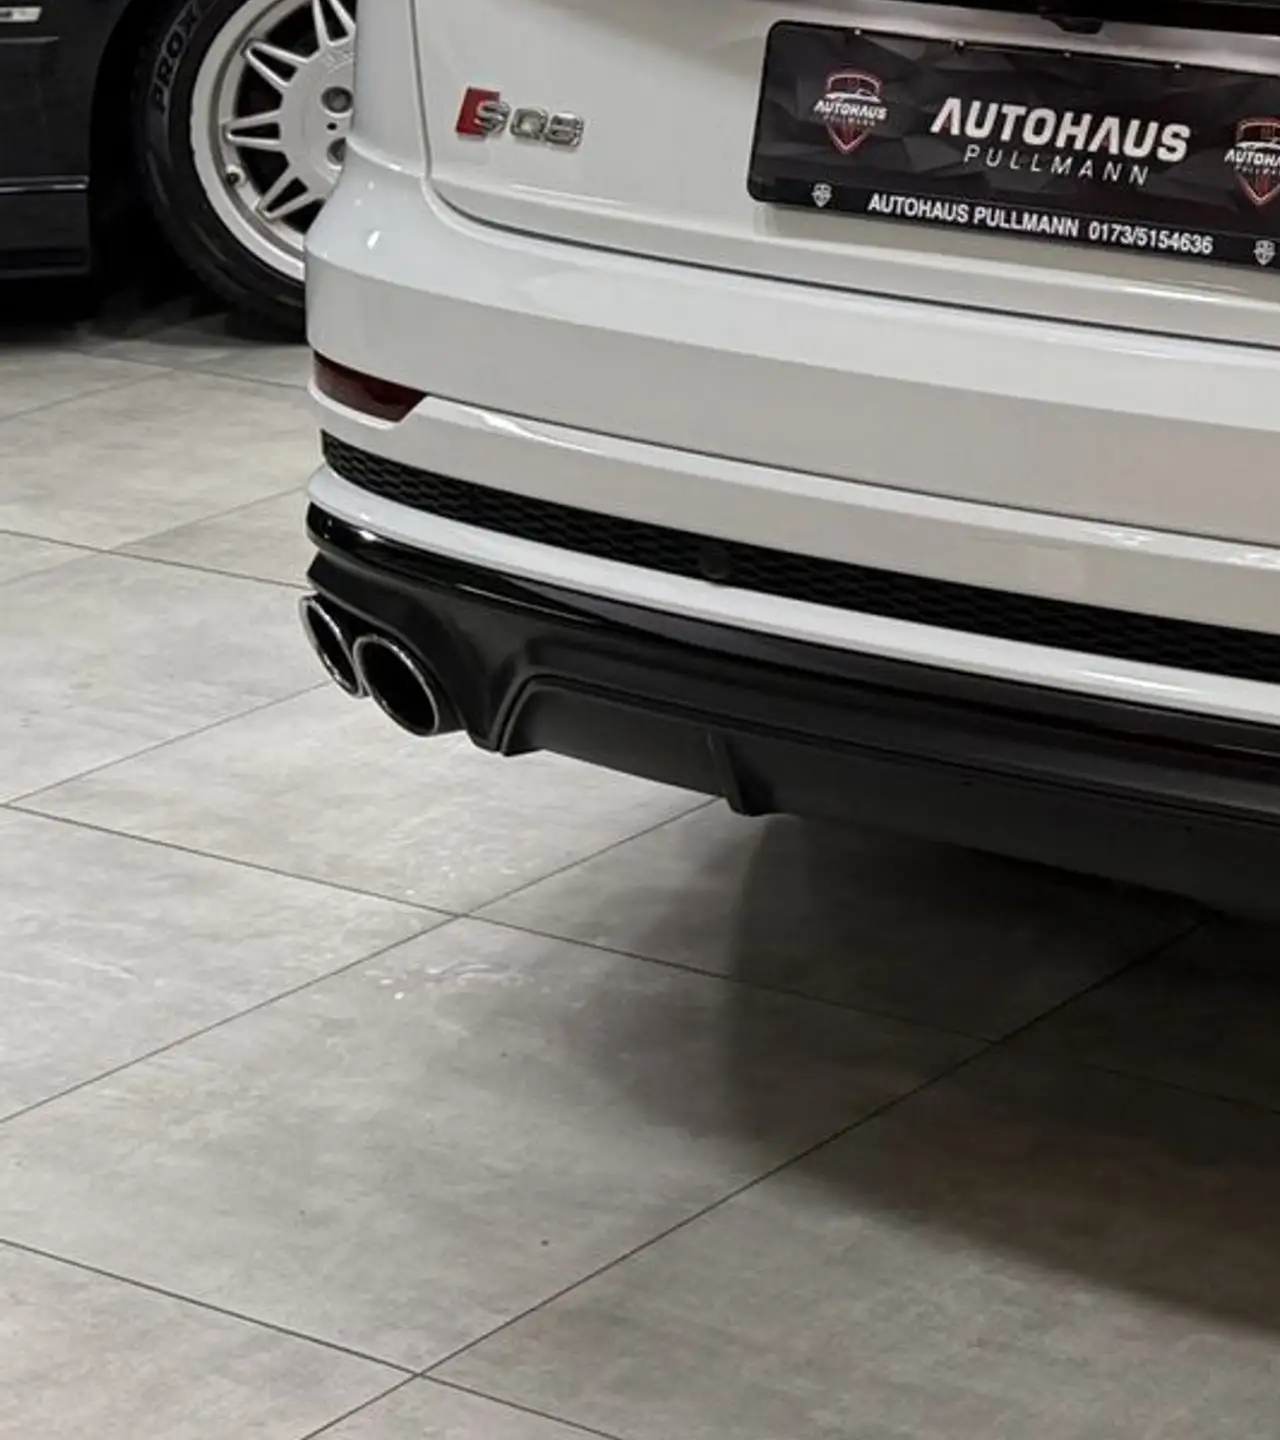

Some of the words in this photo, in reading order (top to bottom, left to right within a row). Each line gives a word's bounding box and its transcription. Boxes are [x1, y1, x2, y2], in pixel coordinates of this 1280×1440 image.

[813, 99, 888, 121] AUTOHAUS
[930, 96, 1191, 162] AUTOHAUS
[963, 144, 1149, 186] PULLMANN
[868, 192, 969, 223] AUTOHAUS
[973, 207, 1079, 237] PULLMANN
[1088, 220, 1214, 255] 0173/5154636
